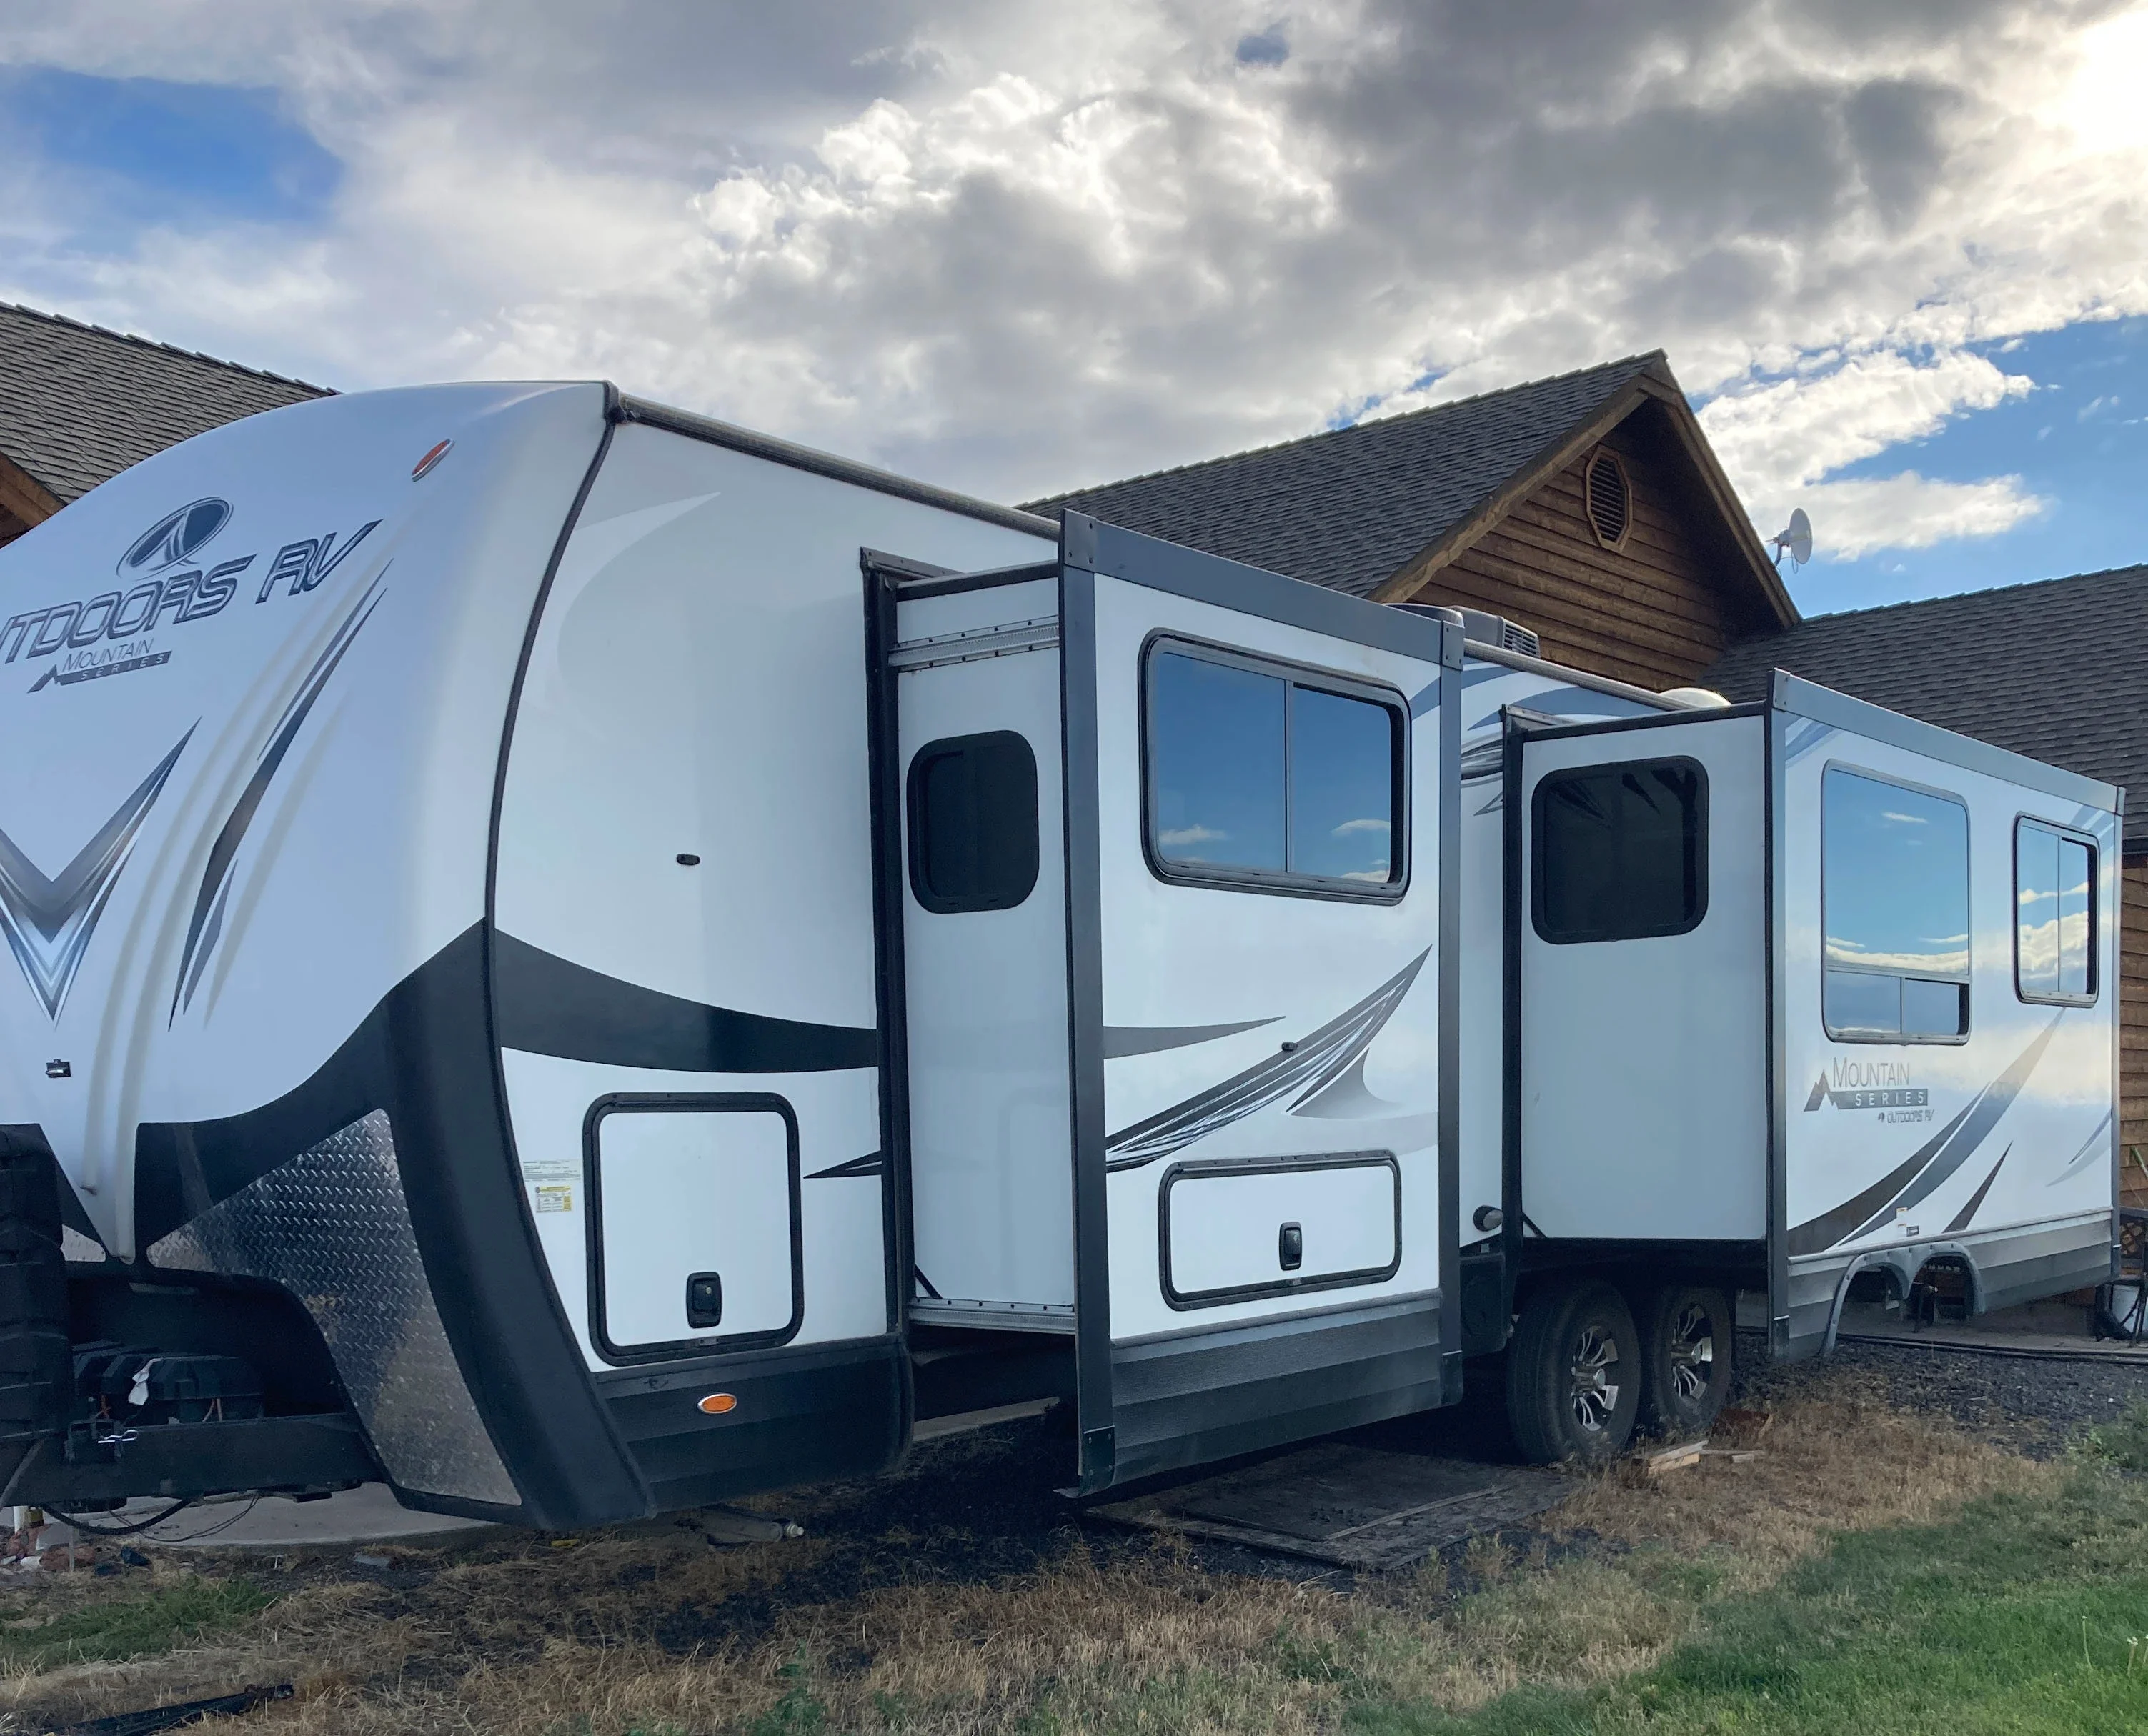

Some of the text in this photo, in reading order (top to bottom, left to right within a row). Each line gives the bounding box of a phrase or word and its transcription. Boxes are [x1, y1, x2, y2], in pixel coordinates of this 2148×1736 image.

[255, 519, 383, 604] RV
[63, 639, 154, 673] MOUNTAIN
[80, 653, 164, 680] SERIES
[1833, 1057, 1910, 1088] MOUNTAIN
[1855, 1091, 1924, 1107] SERIES
